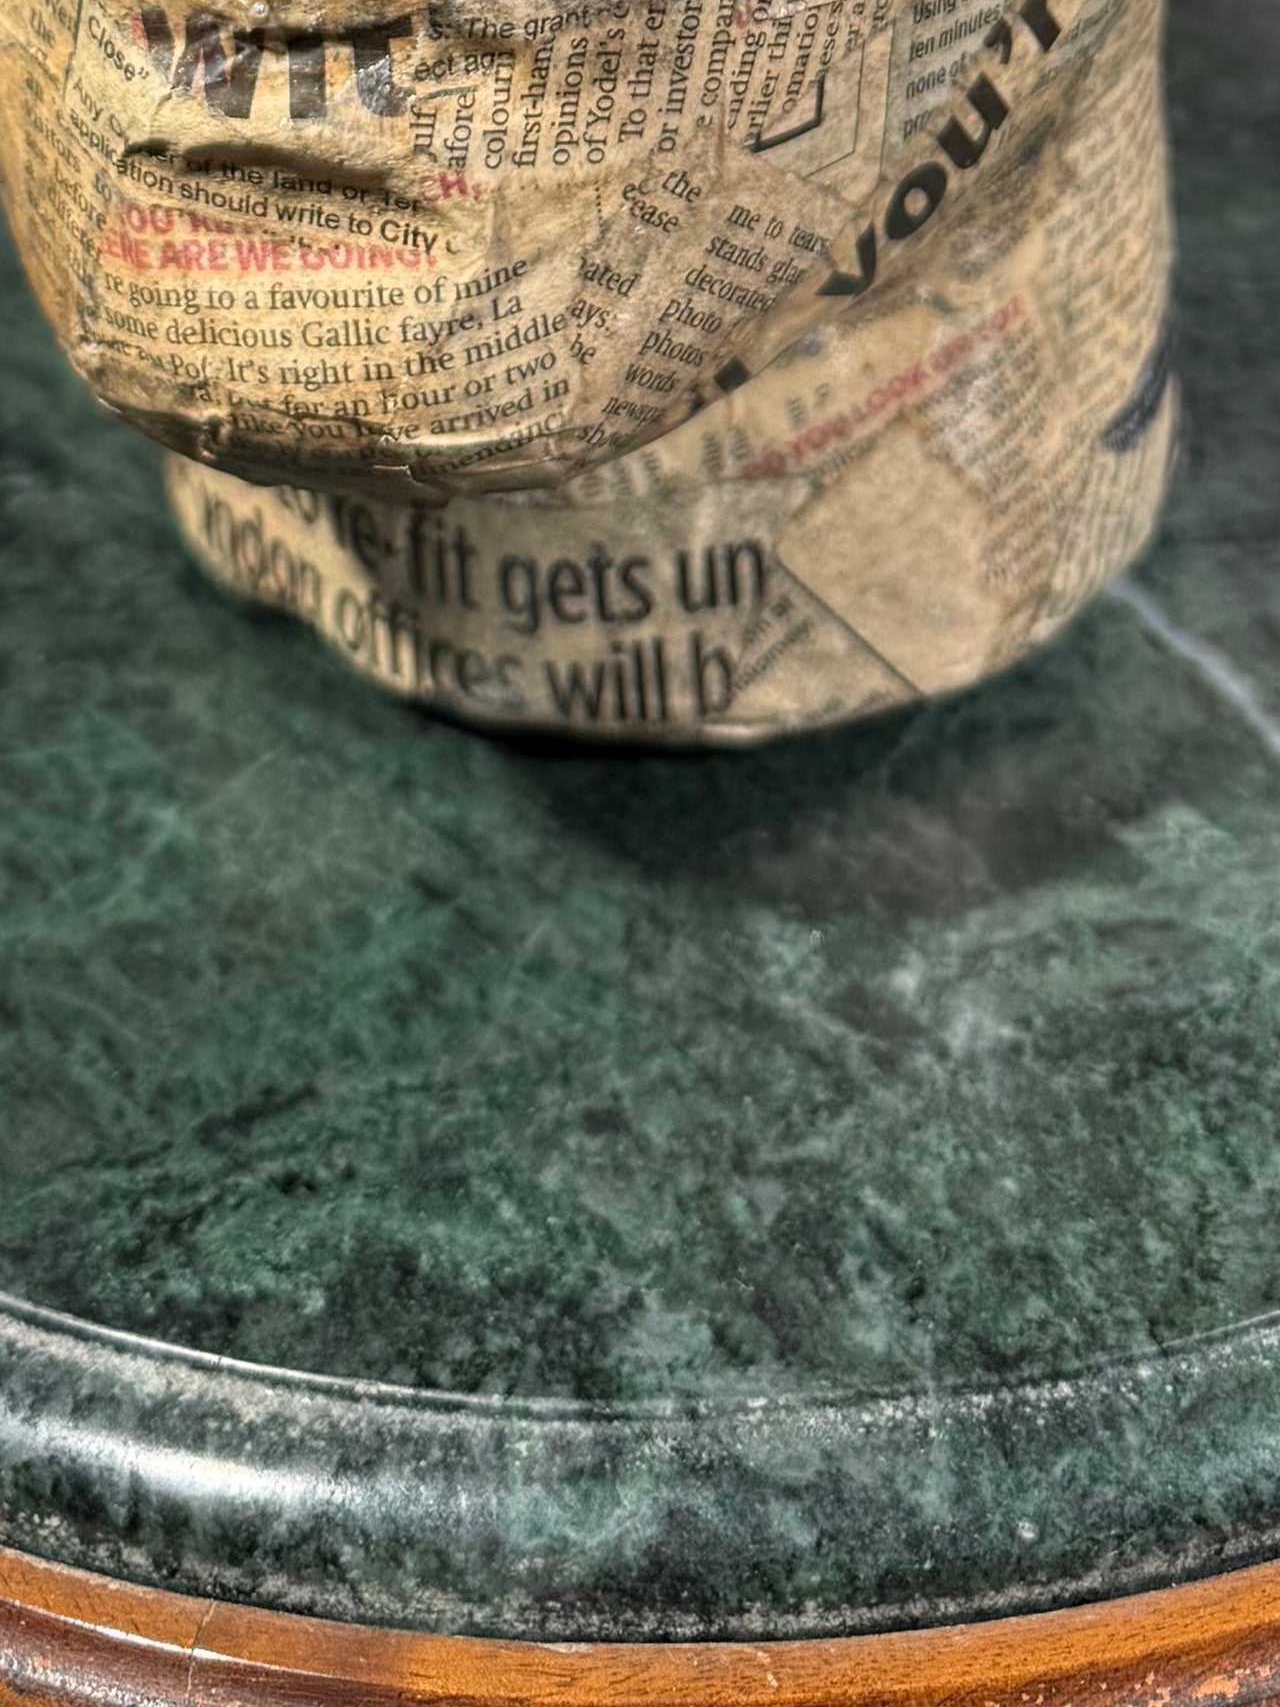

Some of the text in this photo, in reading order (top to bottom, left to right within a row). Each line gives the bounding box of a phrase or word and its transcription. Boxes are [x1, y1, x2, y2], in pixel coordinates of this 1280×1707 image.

[908, 6, 1001, 62] ten minutes
[583, 28, 626, 165] of Yodel's
[628, 38, 660, 99] that
[905, 67, 946, 100] none
[551, 36, 588, 165] opinions
[617, 108, 647, 142] To
[272, 170, 332, 194] land
[661, 170, 702, 204] the
[180, 178, 438, 254] should write to City
[725, 204, 784, 240] me to
[704, 234, 767, 273] stands
[104, 310, 158, 340] some
[165, 318, 292, 349] delicious
[299, 319, 391, 348] Gallic
[491, 290, 524, 322] La
[129, 282, 199, 314] going
[207, 288, 236, 310] to
[243, 291, 261, 310] a
[268, 279, 405, 312] favourite
[413, 276, 446, 304] of
[227, 312, 565, 391] It's right in the middle
[463, 373, 496, 398] or
[503, 350, 557, 386] two
[429, 376, 571, 437] arrived in
[498, 540, 656, 635] gets
[546, 635, 666, 723] will
